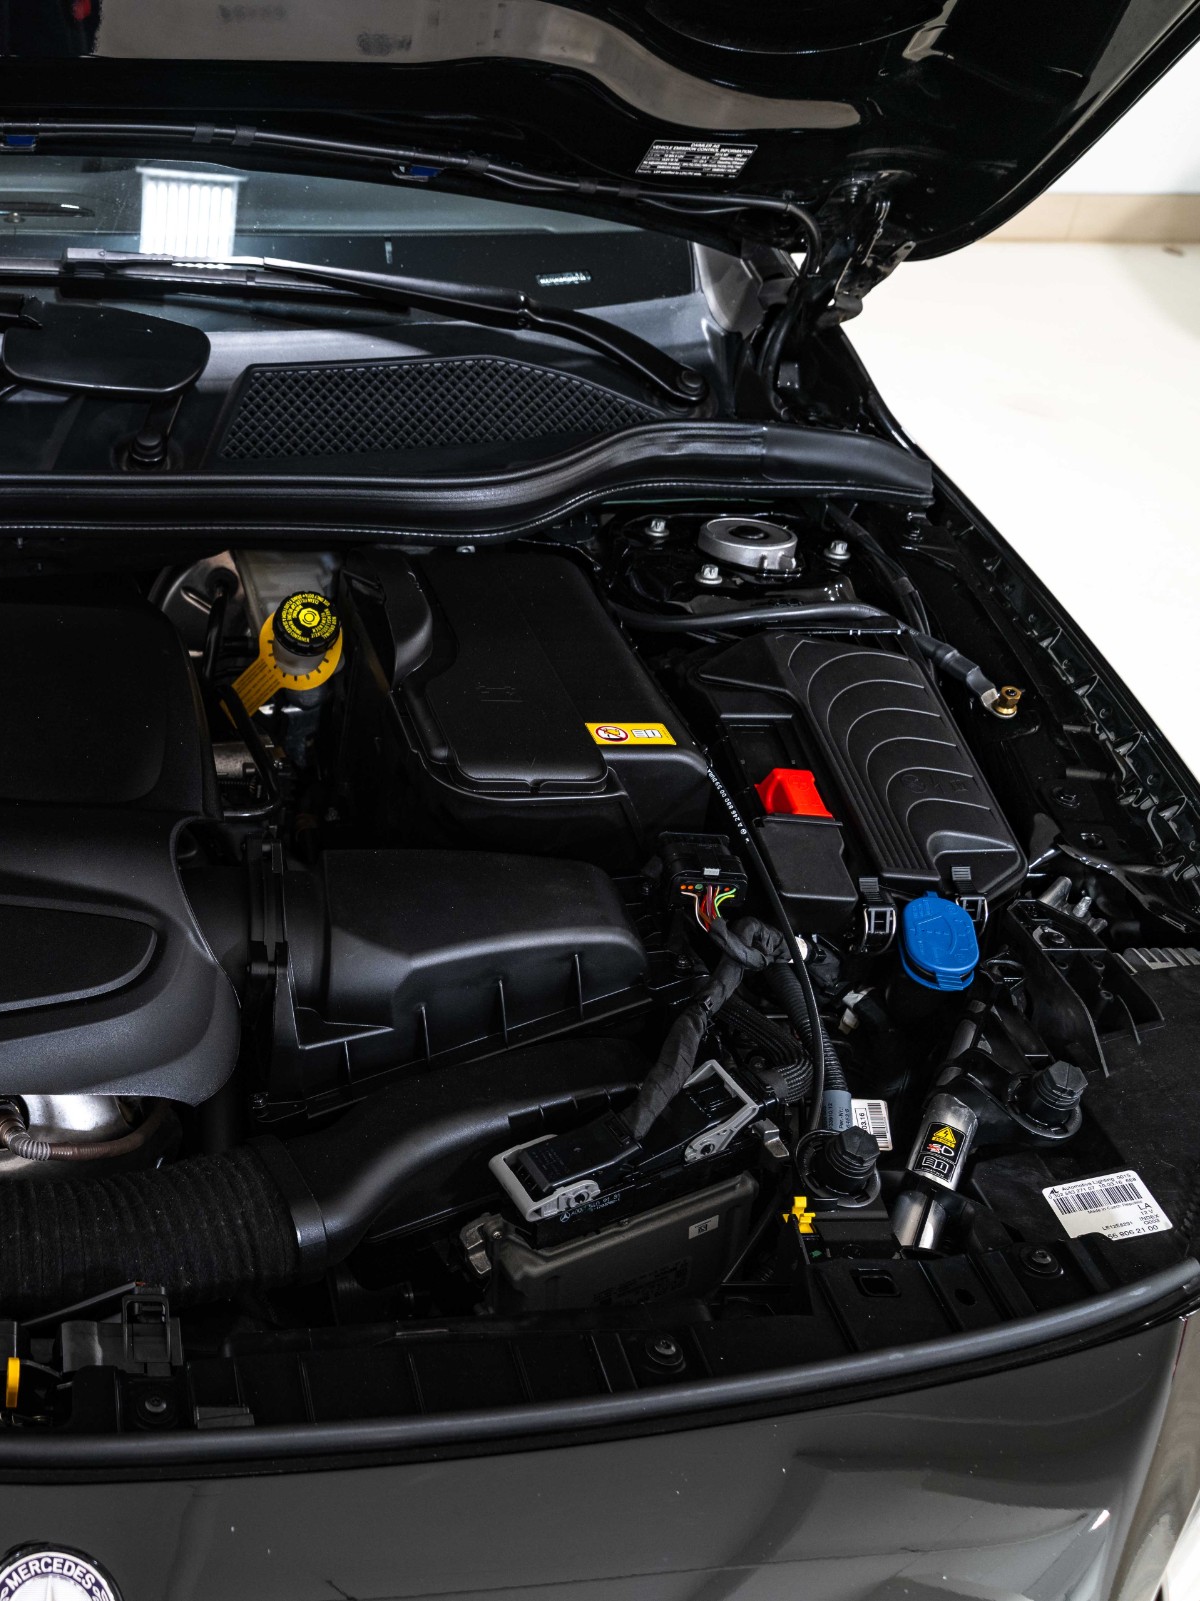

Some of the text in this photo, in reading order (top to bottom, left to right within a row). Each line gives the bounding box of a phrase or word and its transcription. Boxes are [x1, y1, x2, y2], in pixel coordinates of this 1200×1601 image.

[1061, 1182, 1092, 1191] Automotive
[1092, 1177, 1115, 1186] Lighting
[5, 1558, 95, 1591] MERCEDES
